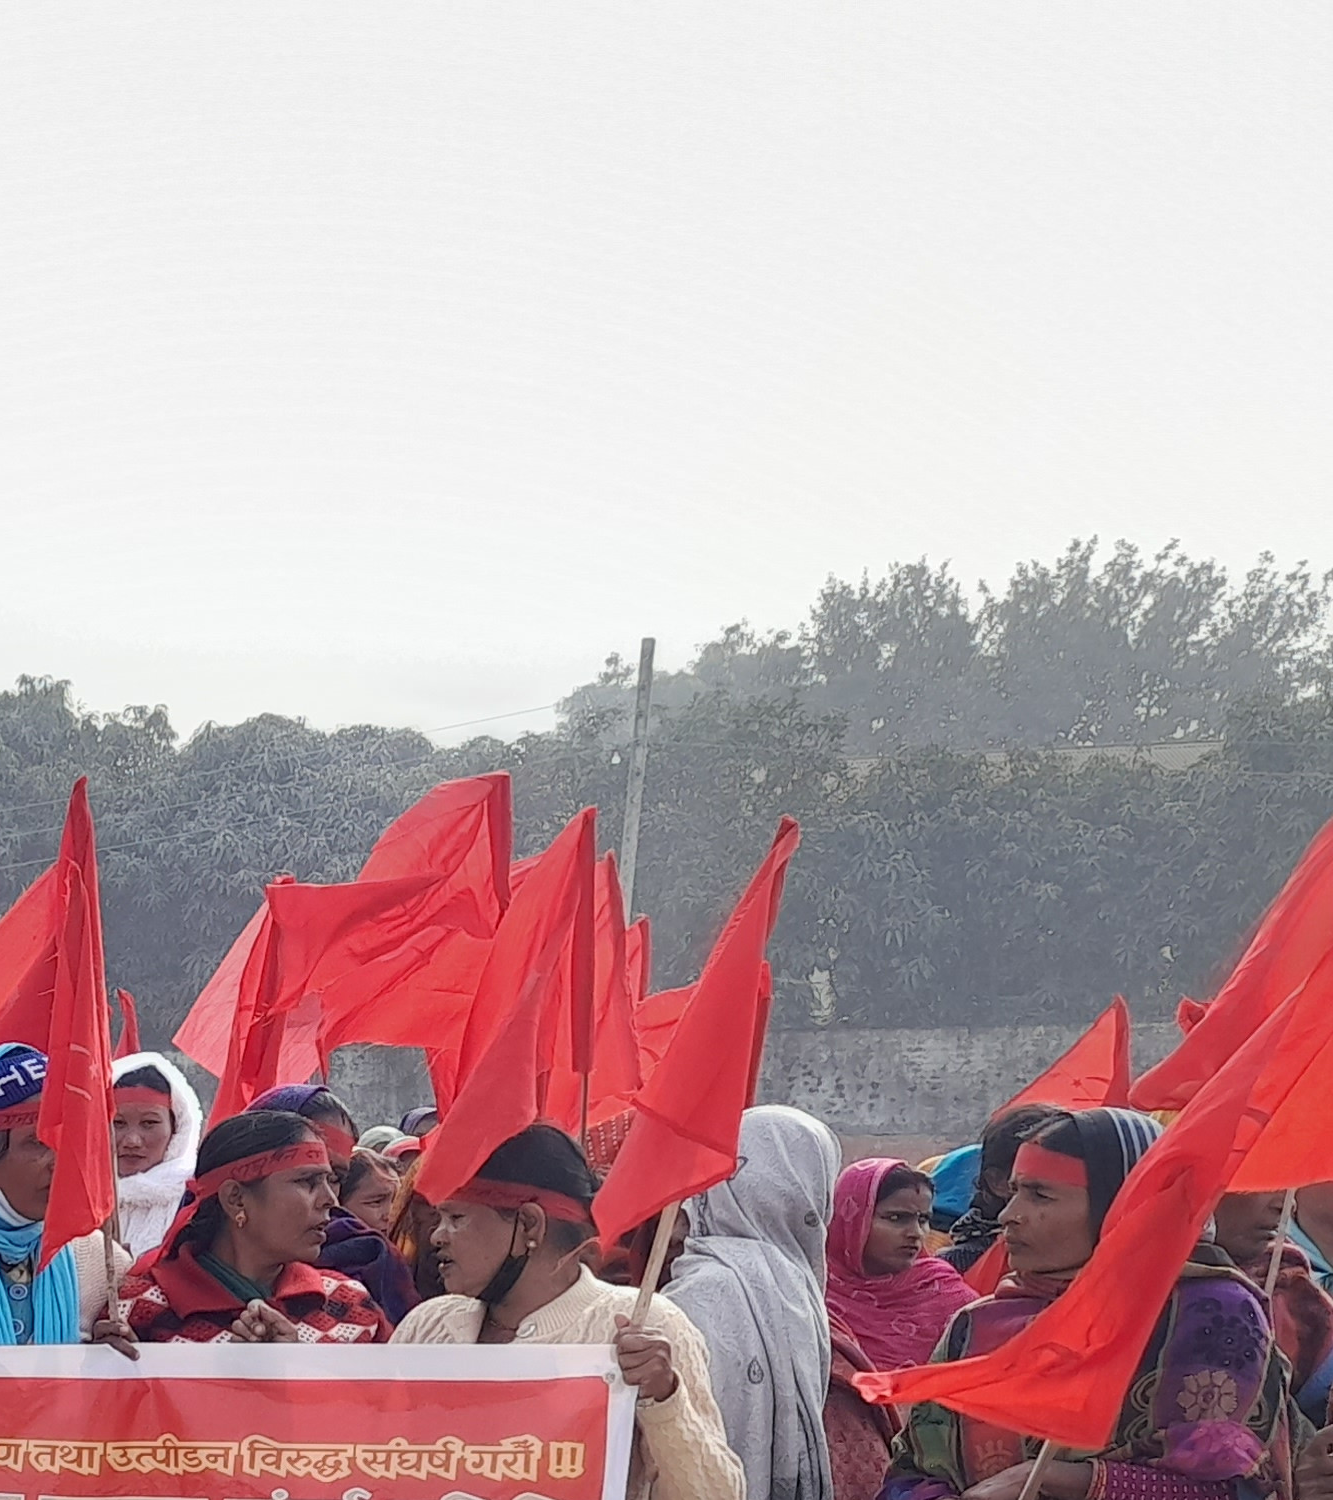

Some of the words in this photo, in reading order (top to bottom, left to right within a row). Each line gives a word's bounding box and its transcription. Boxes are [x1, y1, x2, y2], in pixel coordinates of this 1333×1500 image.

[30, 1441, 103, 1475] तथा
[107, 1434, 238, 1476] उत्पीडन
[241, 1435, 353, 1481] विरुद्ध
[356, 1438, 463, 1480] संघर्ष
